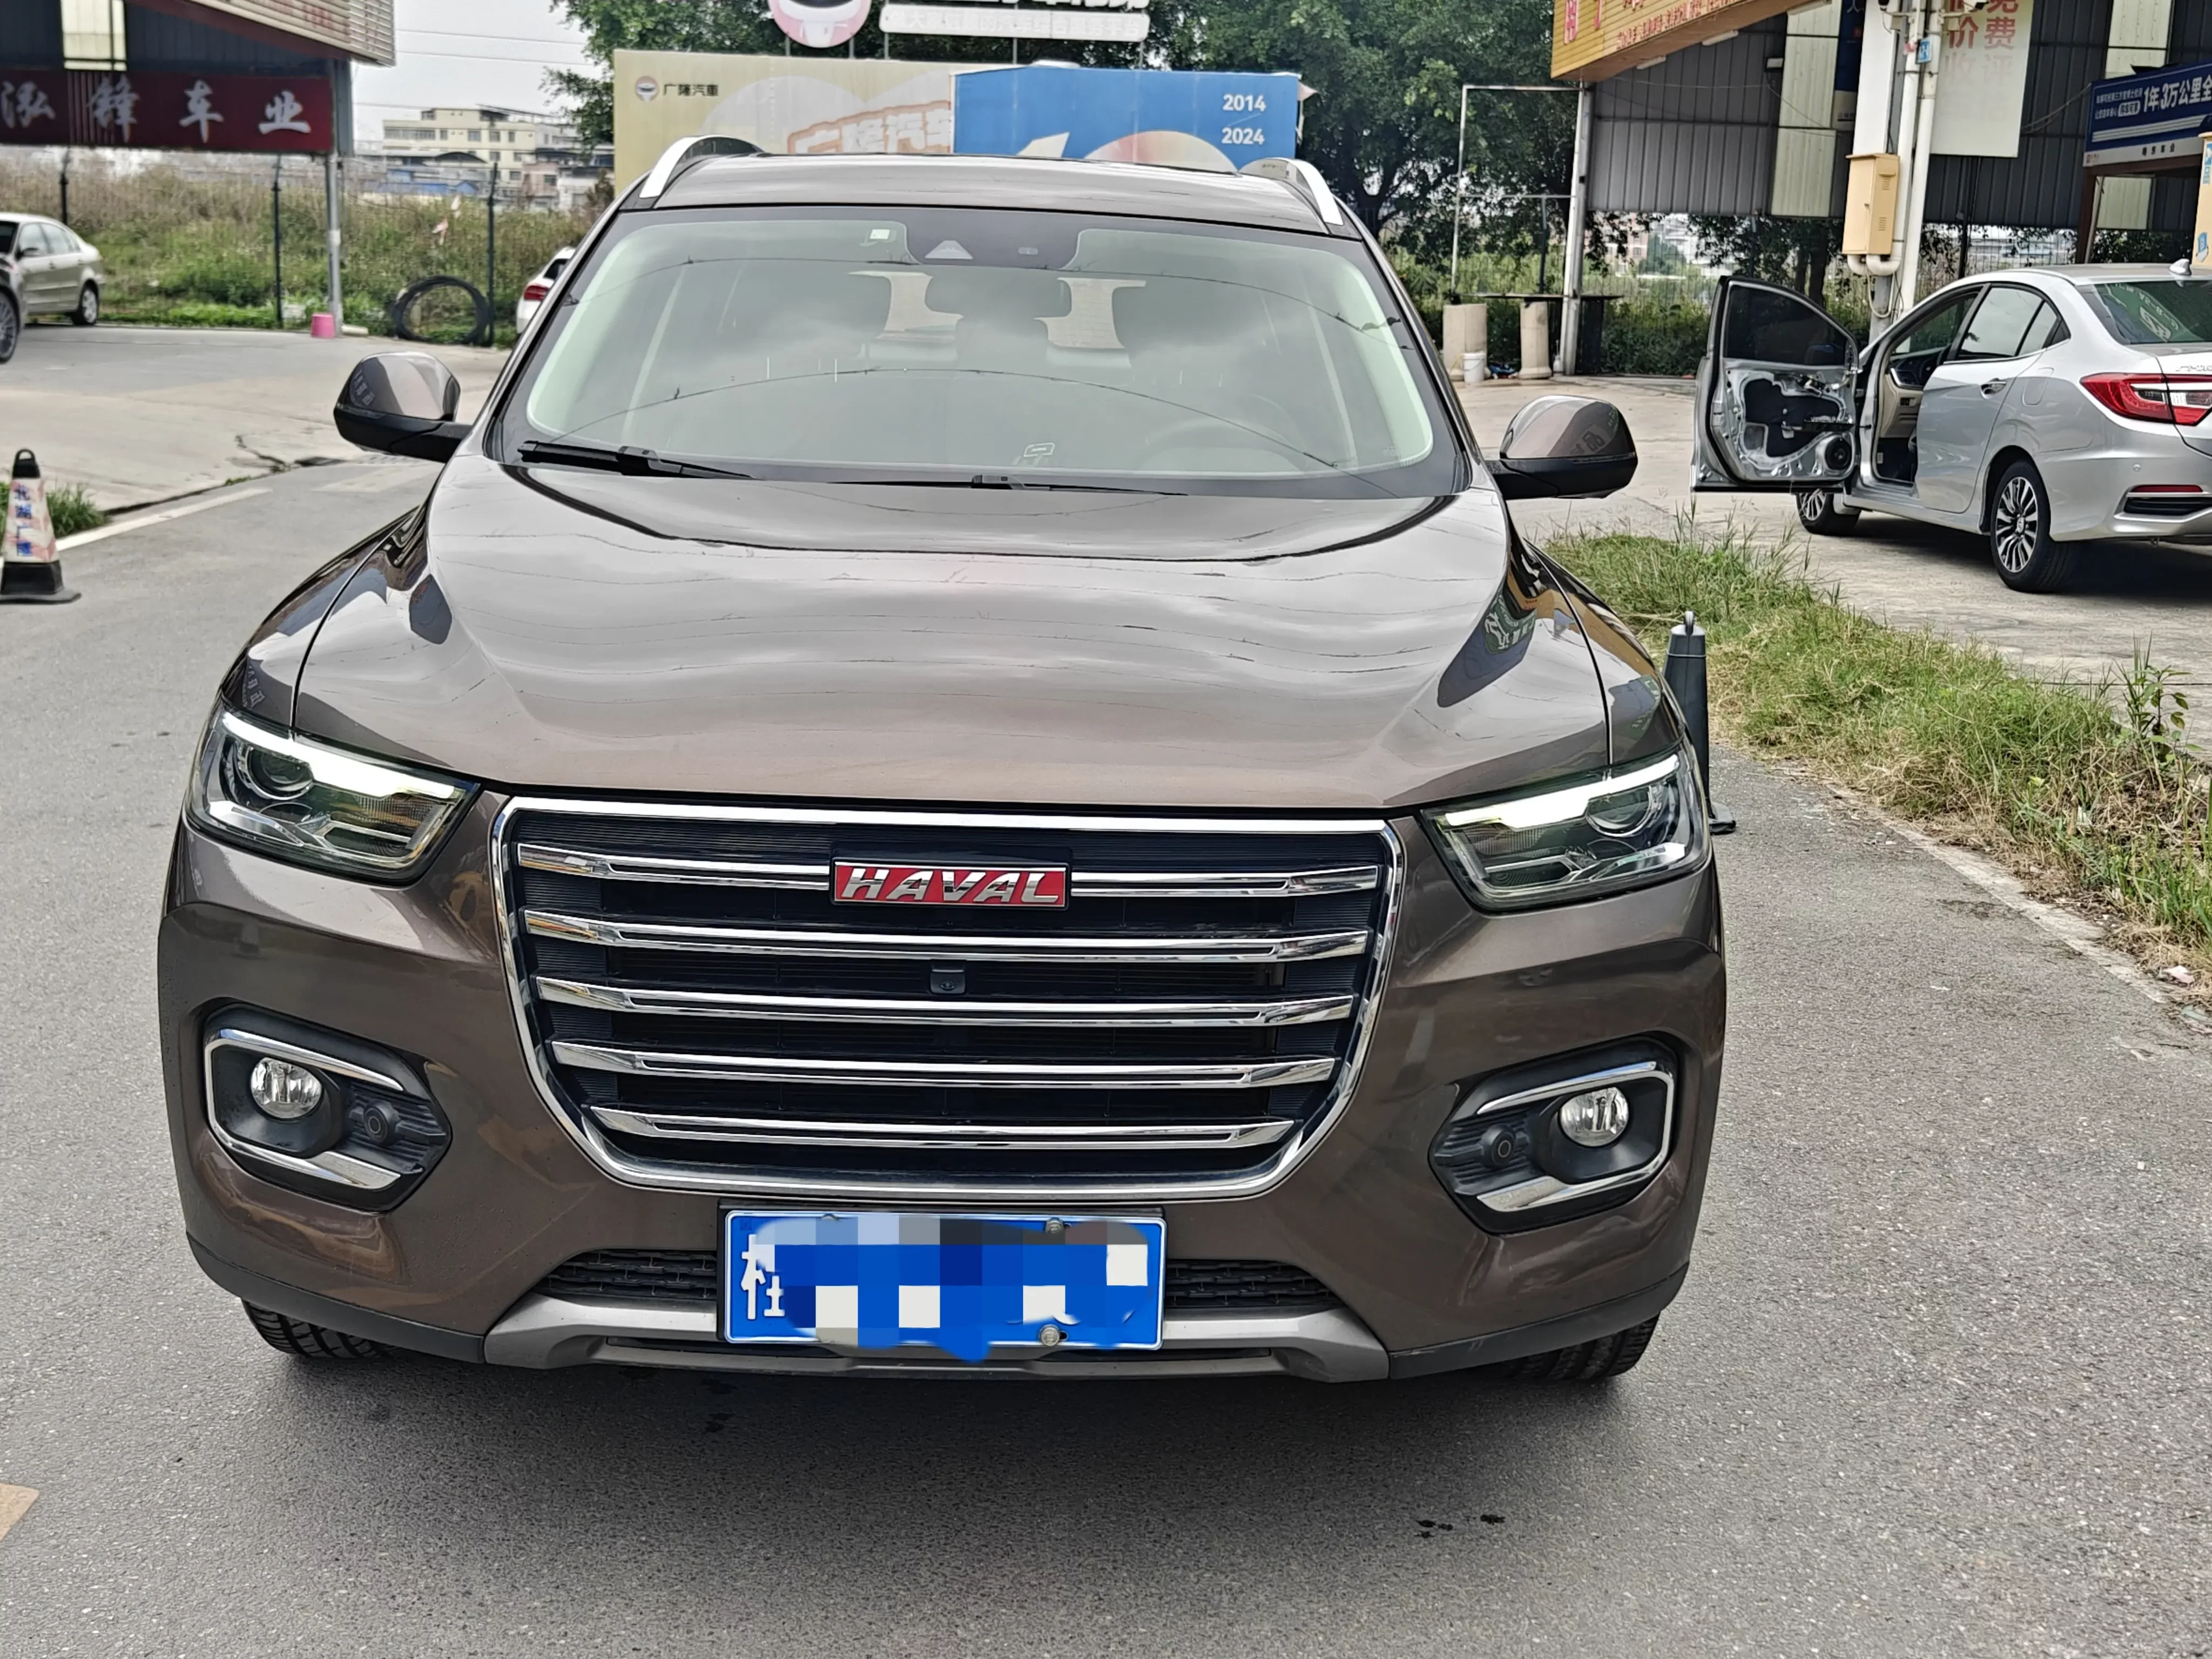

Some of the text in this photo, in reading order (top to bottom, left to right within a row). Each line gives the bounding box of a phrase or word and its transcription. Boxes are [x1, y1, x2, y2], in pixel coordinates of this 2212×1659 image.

[1222, 94, 1267, 112] 2014
[1221, 127, 1265, 145] 2024
[841, 867, 1059, 903] HAVAL
